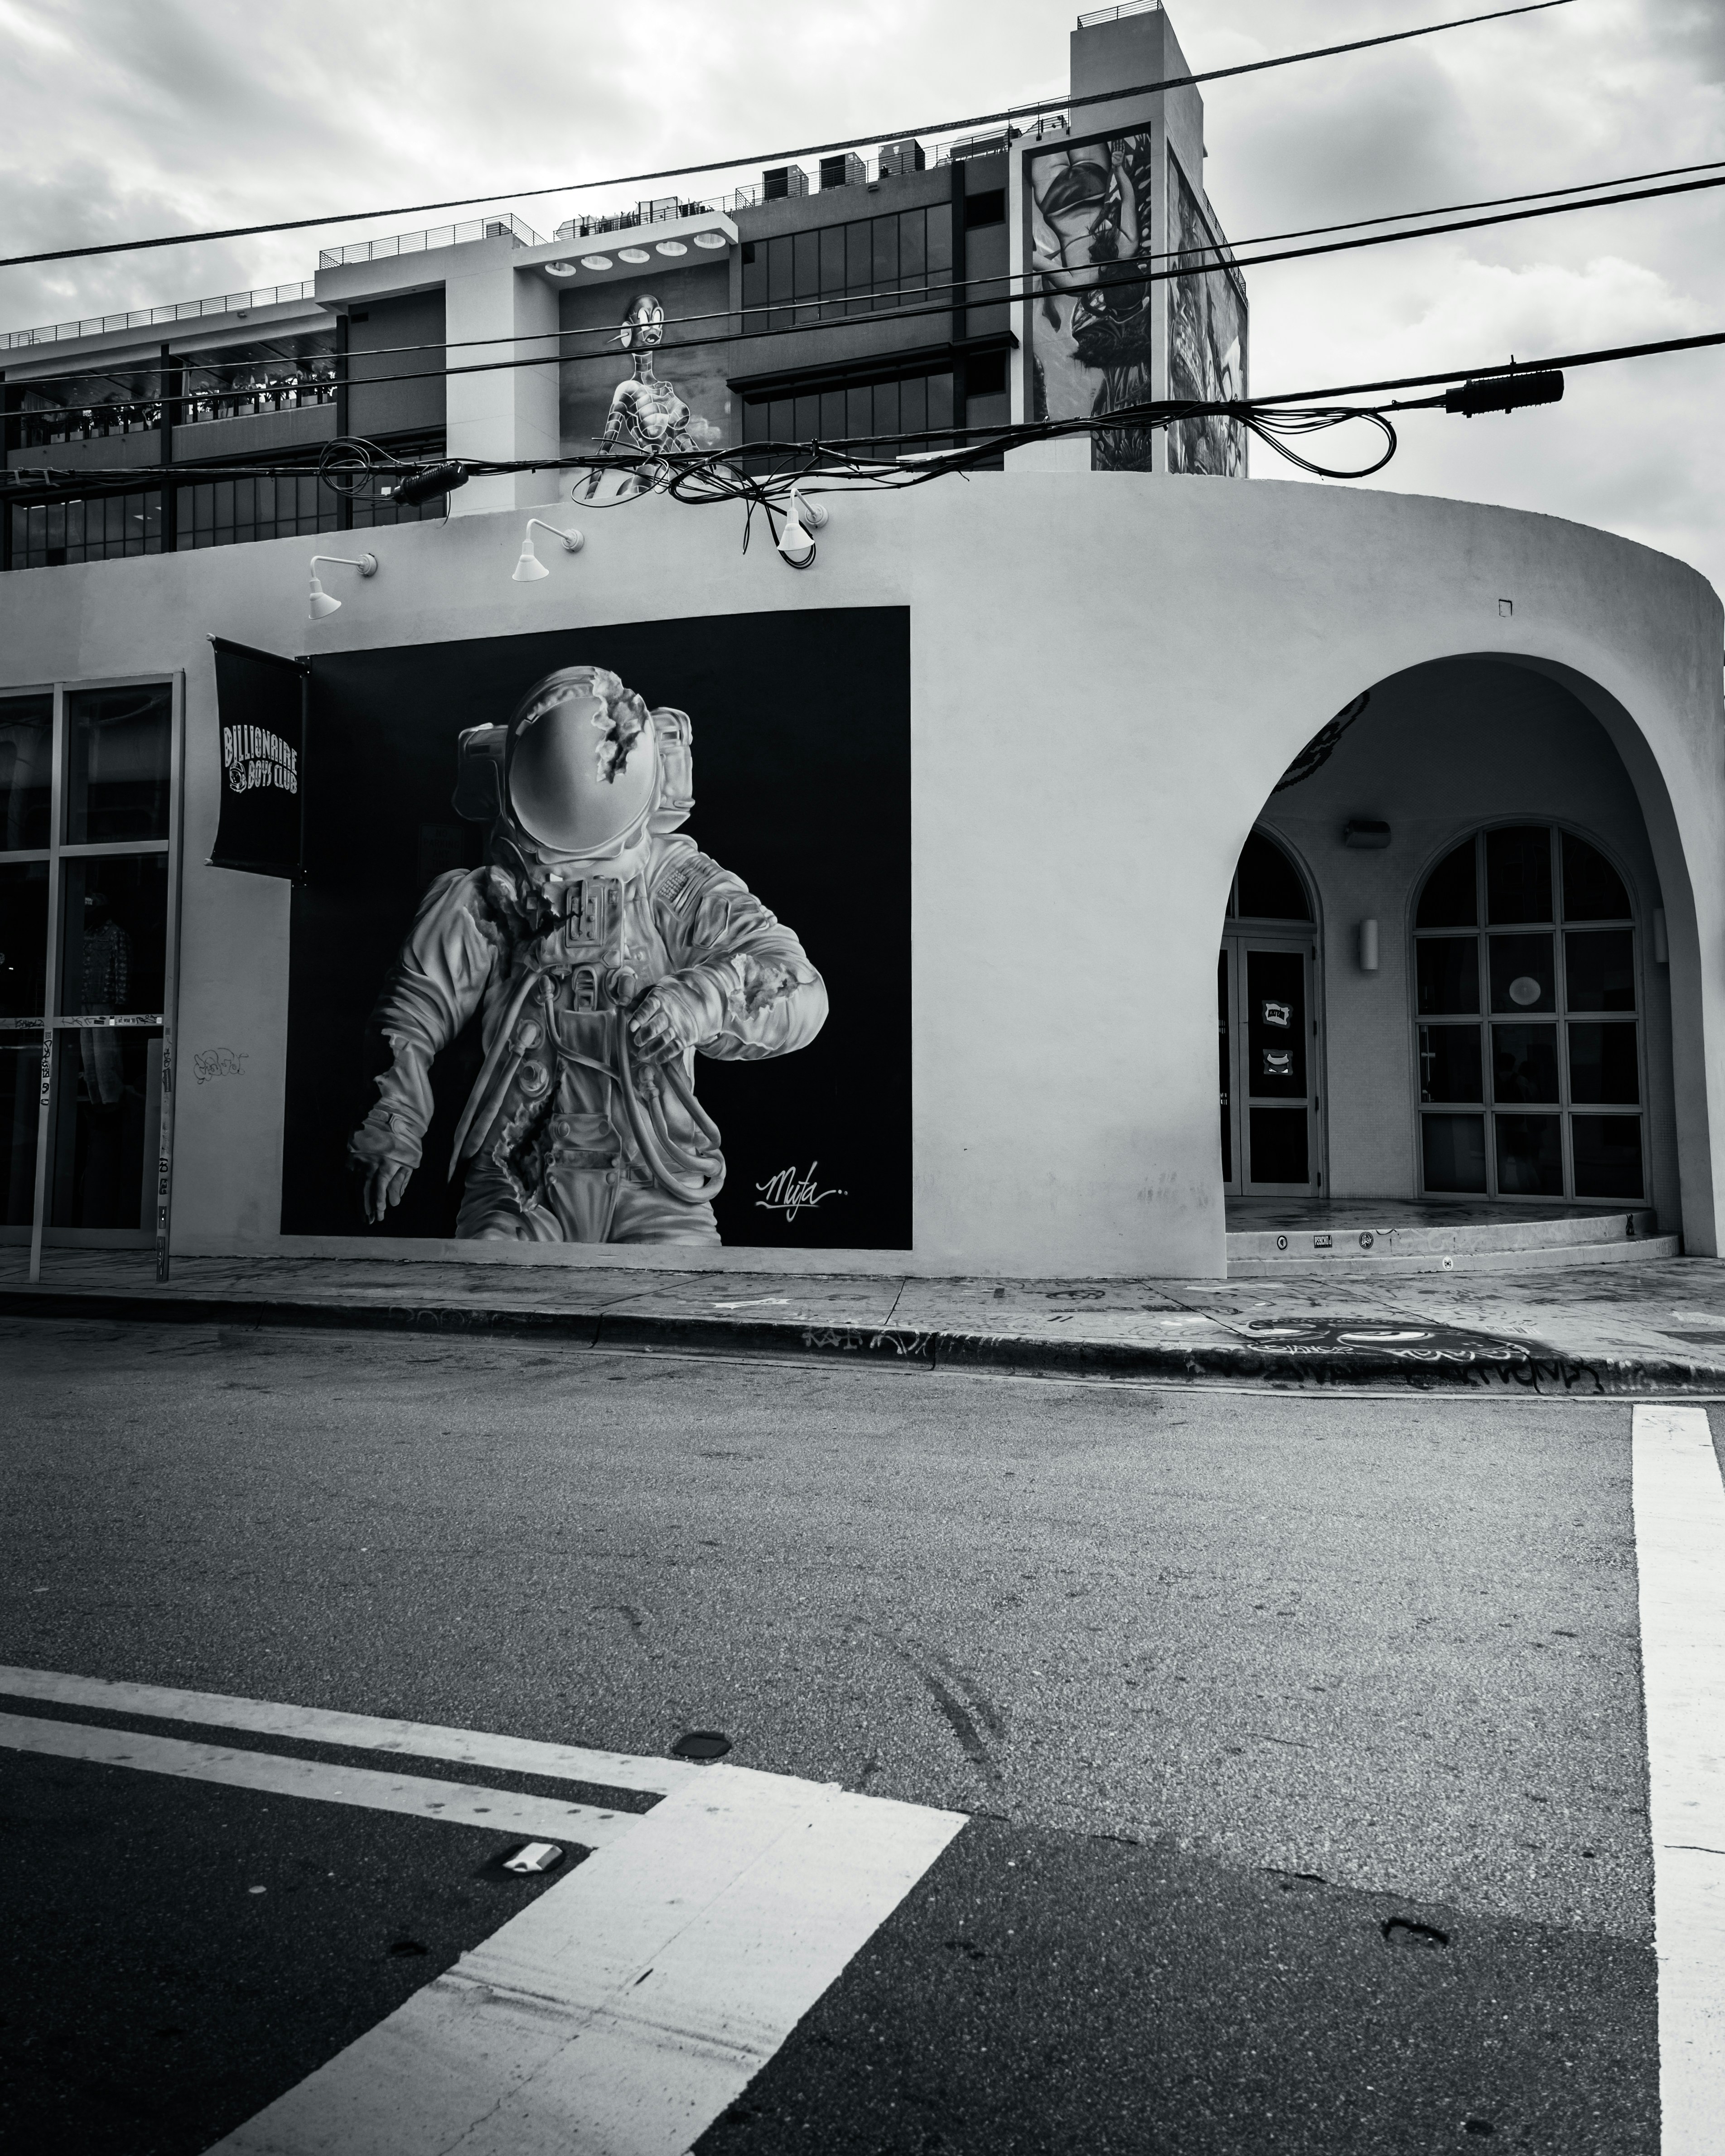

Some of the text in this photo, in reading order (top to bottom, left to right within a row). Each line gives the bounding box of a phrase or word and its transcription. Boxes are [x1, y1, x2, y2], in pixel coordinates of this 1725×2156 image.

[224, 725, 297, 775] BILLIONAIRE
[248, 760, 297, 794] BOYS CLUB
[436, 829, 447, 838] NO
[423, 839, 459, 849] PARKING
[1314, 1236, 1329, 1245] PSYCHO
